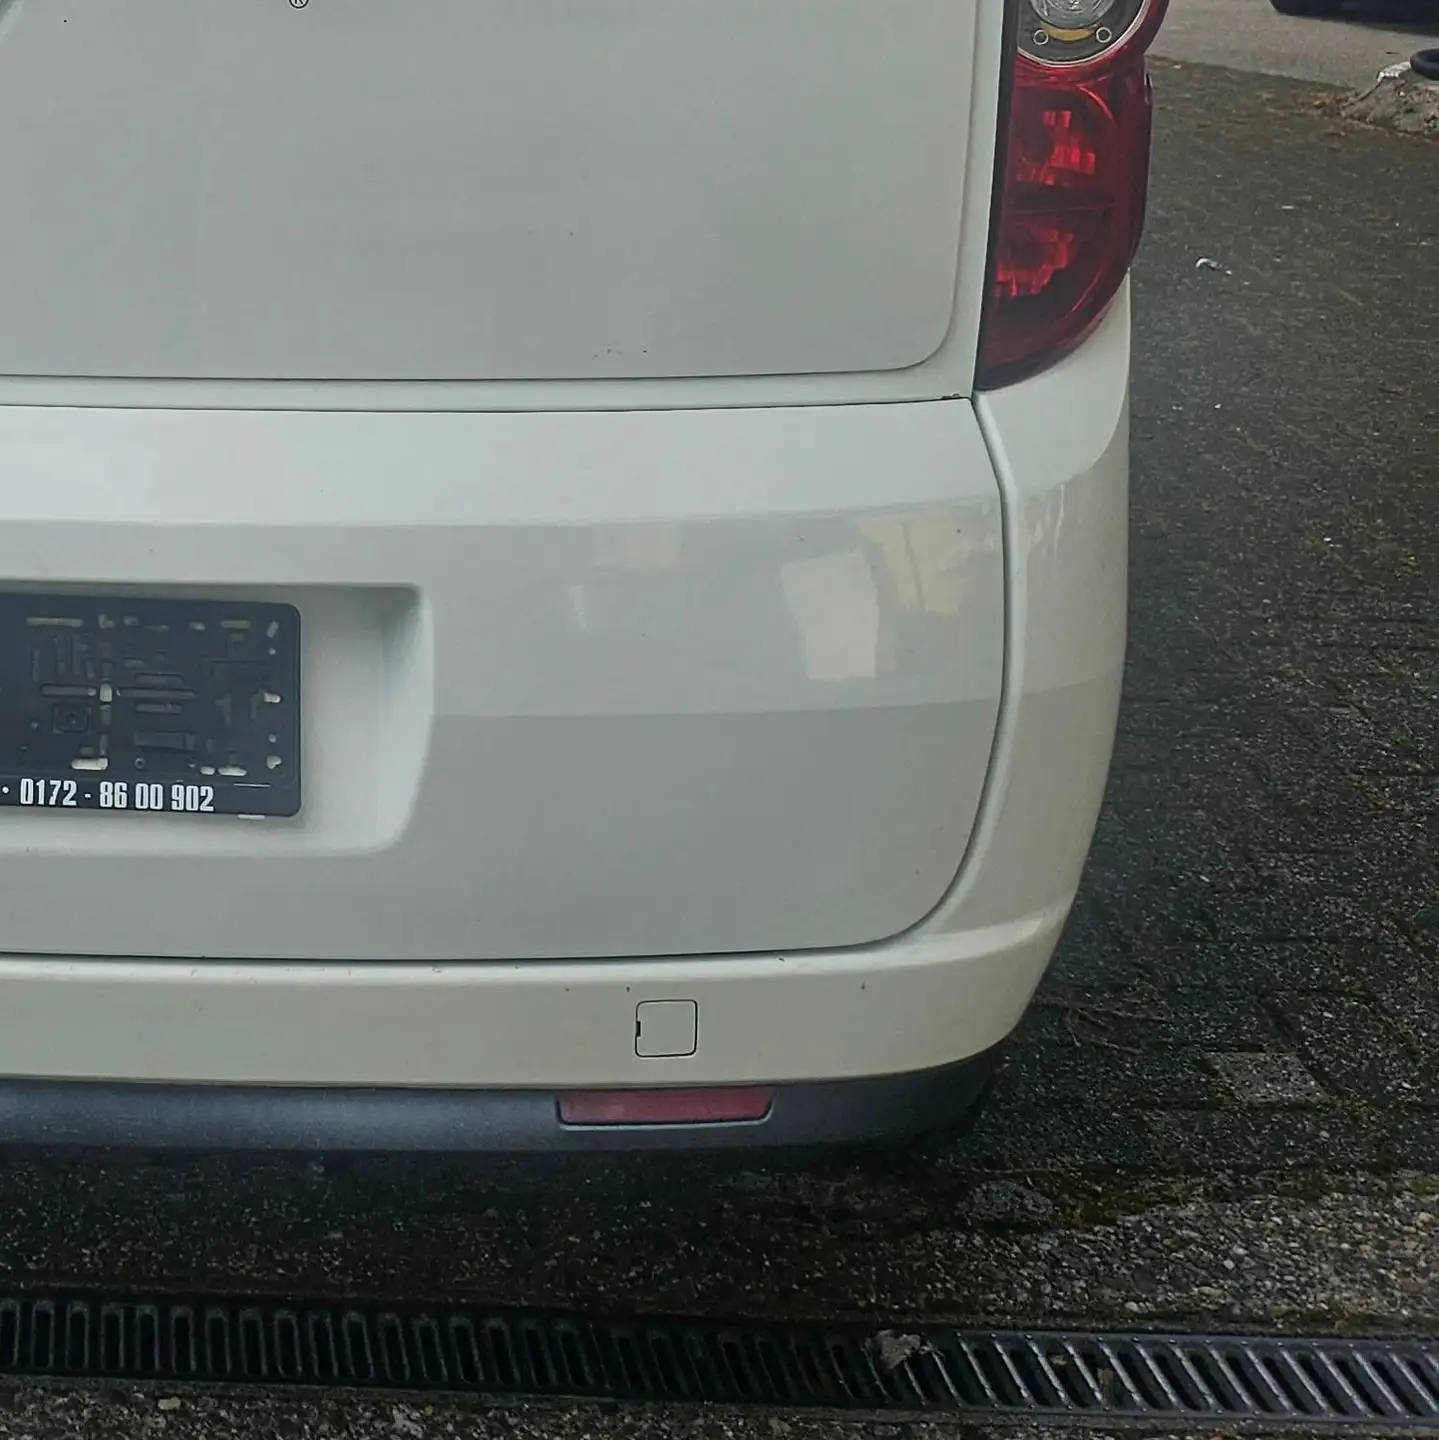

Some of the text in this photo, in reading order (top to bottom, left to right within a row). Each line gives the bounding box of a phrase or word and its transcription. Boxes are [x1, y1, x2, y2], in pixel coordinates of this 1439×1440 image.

[20, 778, 77, 806] 0172
[99, 781, 127, 808] 86
[135, 783, 164, 810] 00
[172, 784, 215, 812] 902
